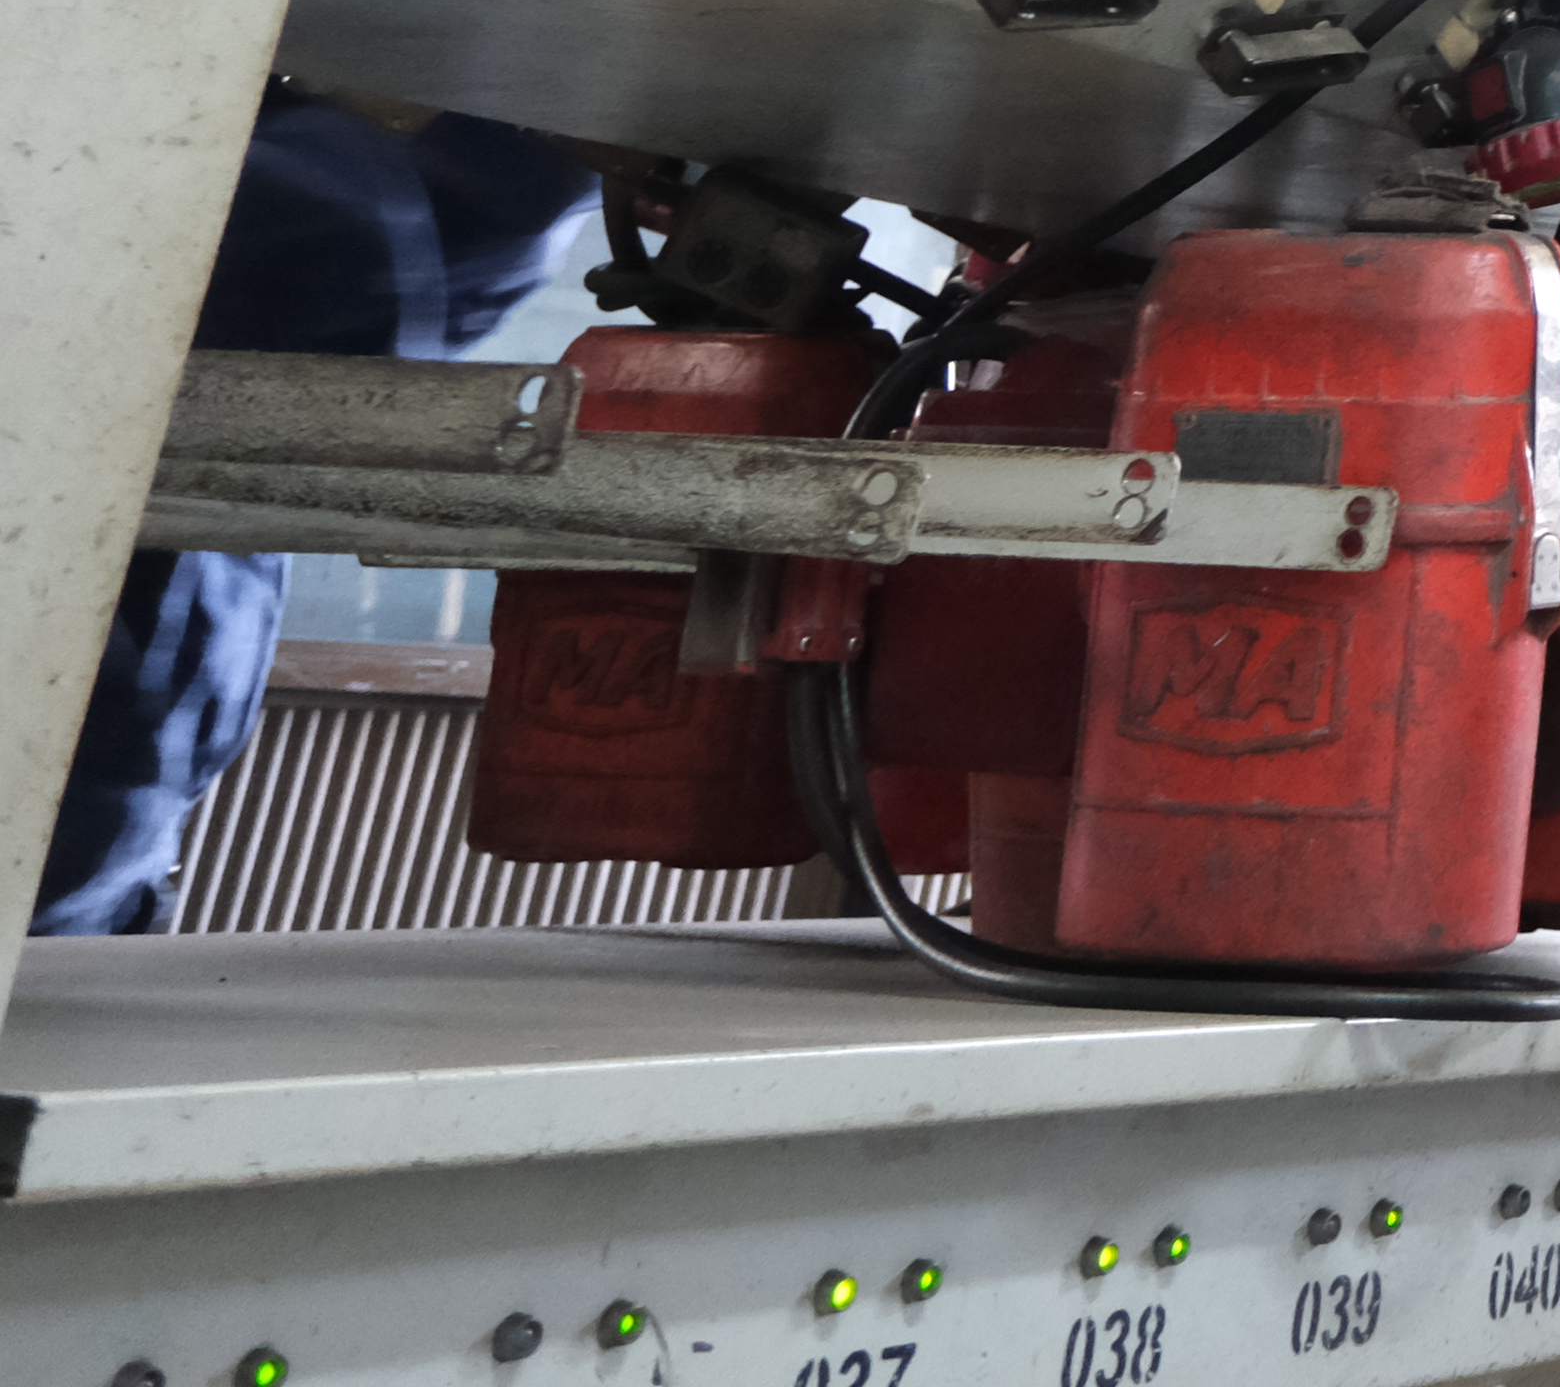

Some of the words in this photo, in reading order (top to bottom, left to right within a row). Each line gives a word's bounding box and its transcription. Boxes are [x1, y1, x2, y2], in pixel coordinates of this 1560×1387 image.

[1131, 619, 1334, 725] MA
[1060, 1303, 1168, 1387] 038
[1290, 1270, 1384, 1356] 039
